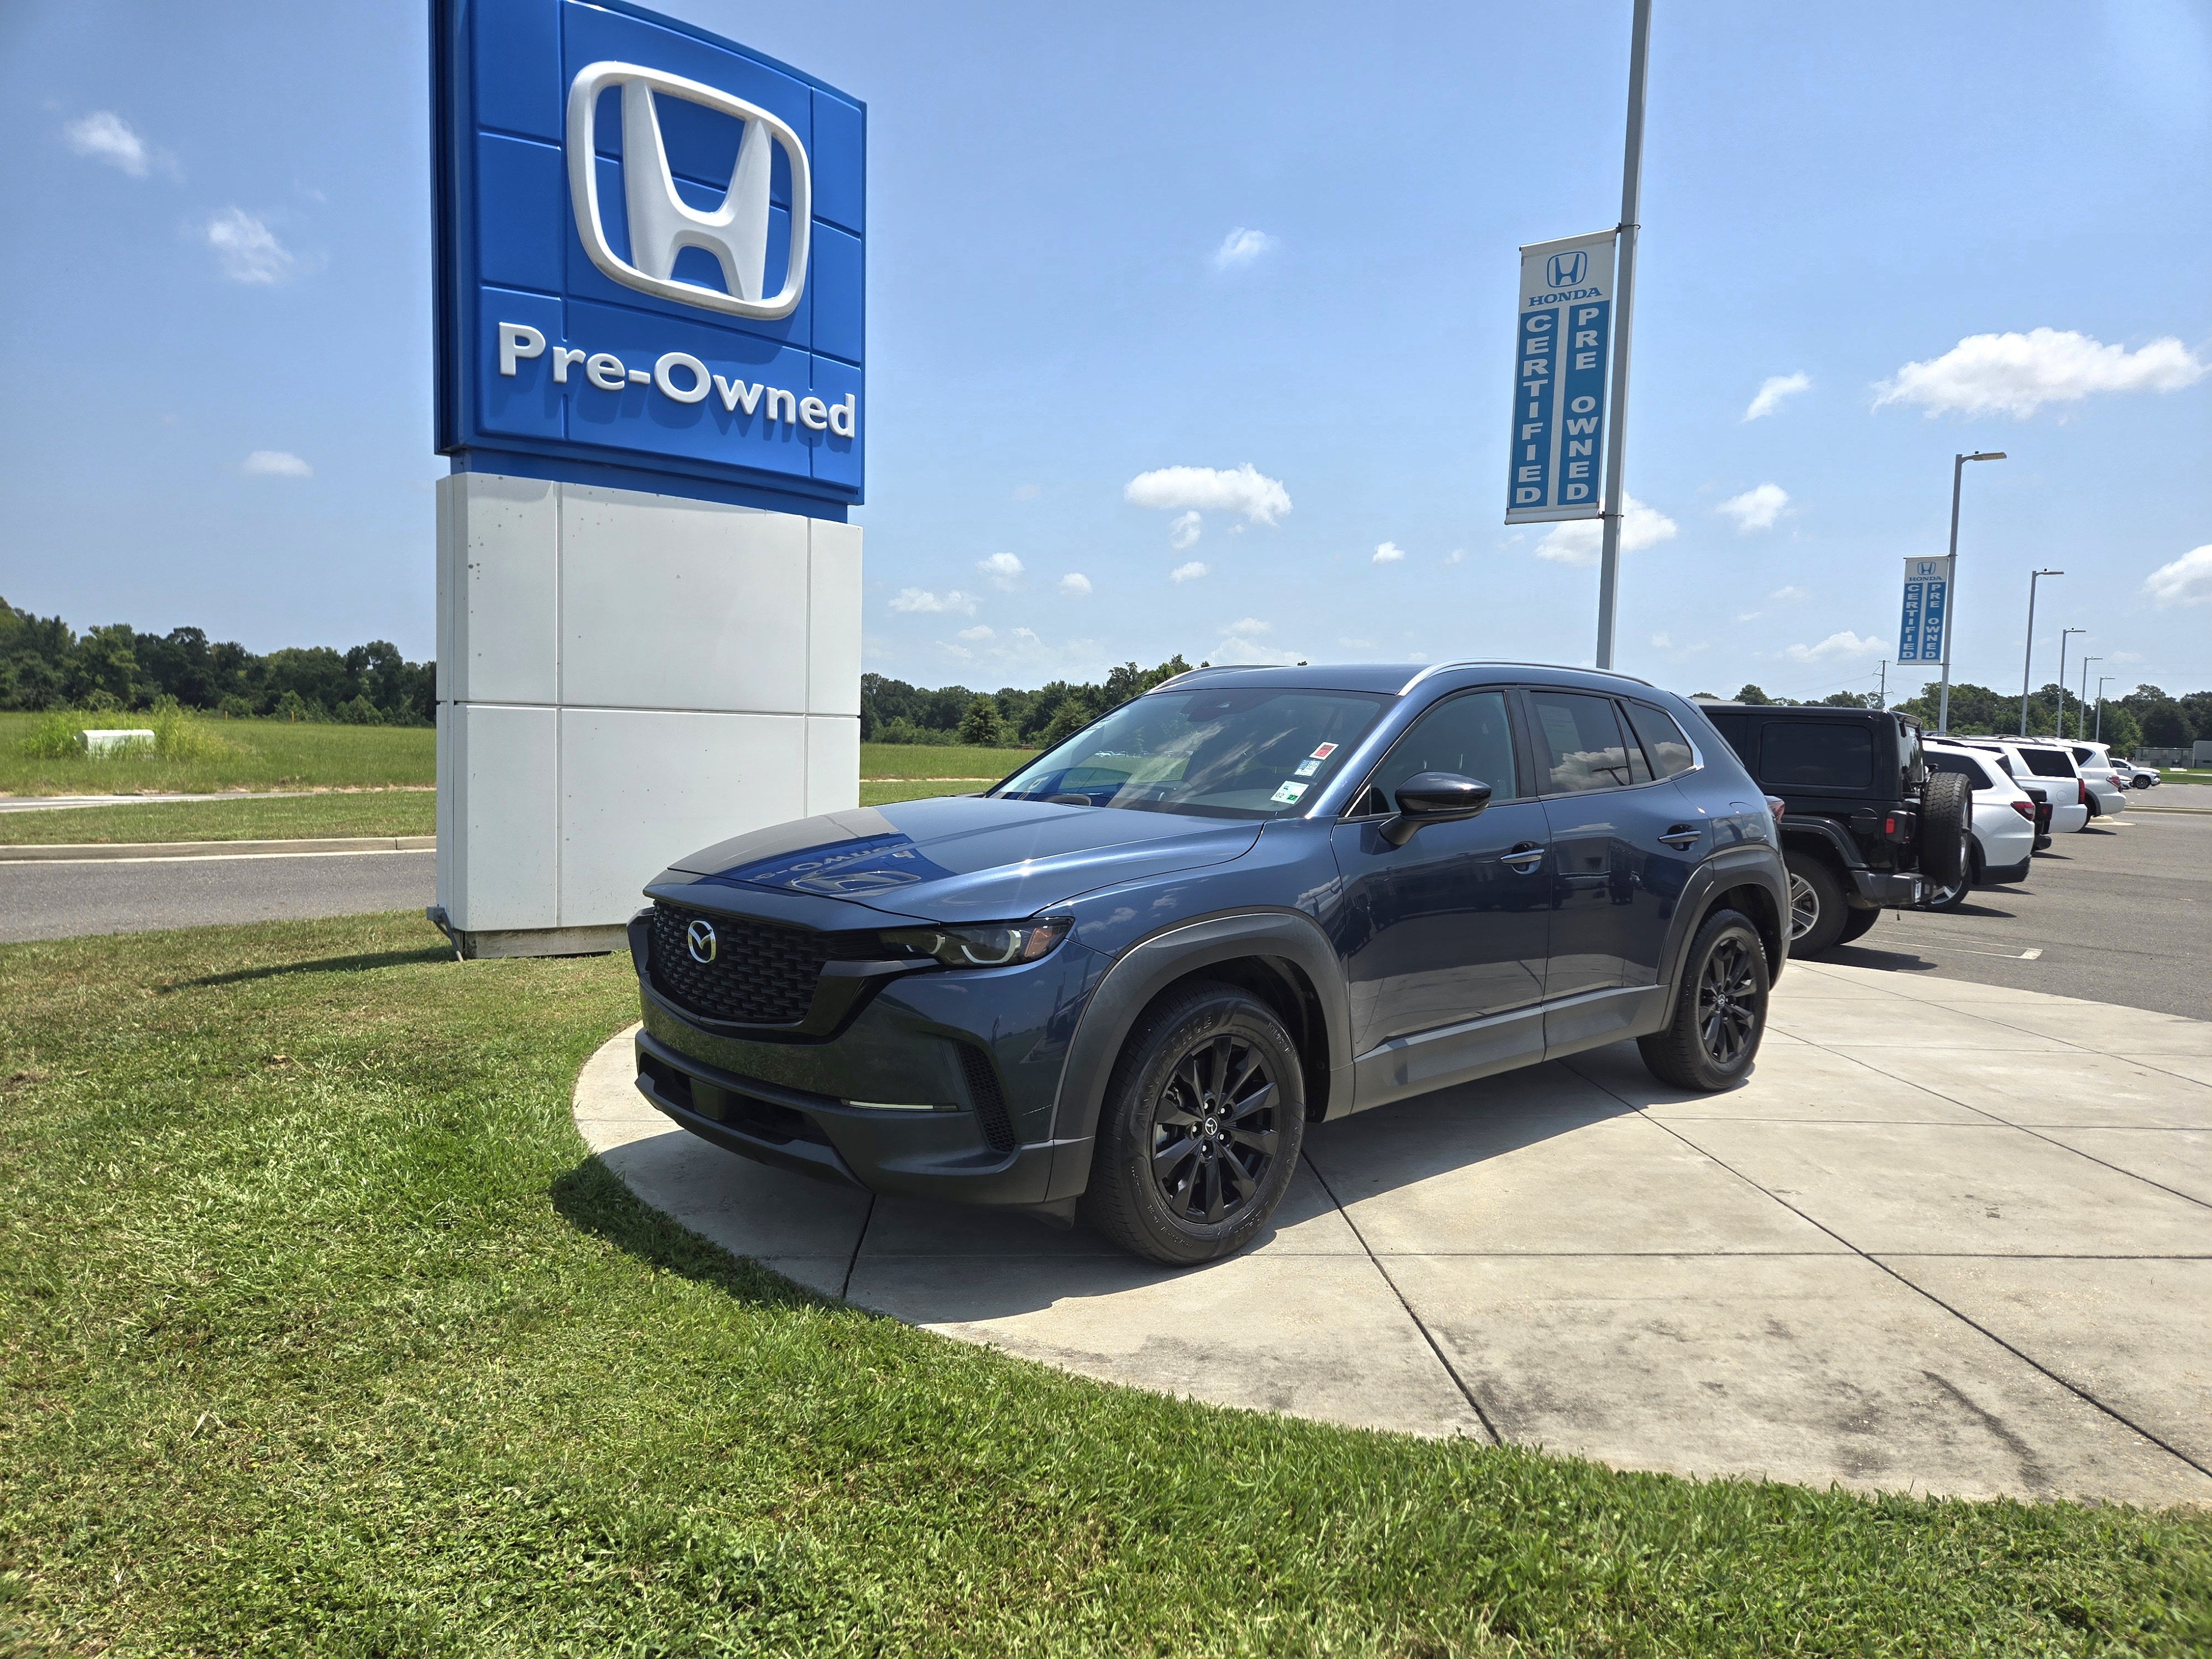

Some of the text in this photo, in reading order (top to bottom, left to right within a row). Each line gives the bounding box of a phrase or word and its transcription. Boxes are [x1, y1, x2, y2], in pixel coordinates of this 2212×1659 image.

[1529, 287, 1603, 307] HONDA
[499, 321, 855, 439] Pre-Owned
[1516, 315, 1552, 504] CERTIFIED
[1566, 307, 1600, 500] PRE OWNED
[1902, 585, 1920, 658] CERTIFIED
[1926, 584, 1941, 658] PRE OWNED
